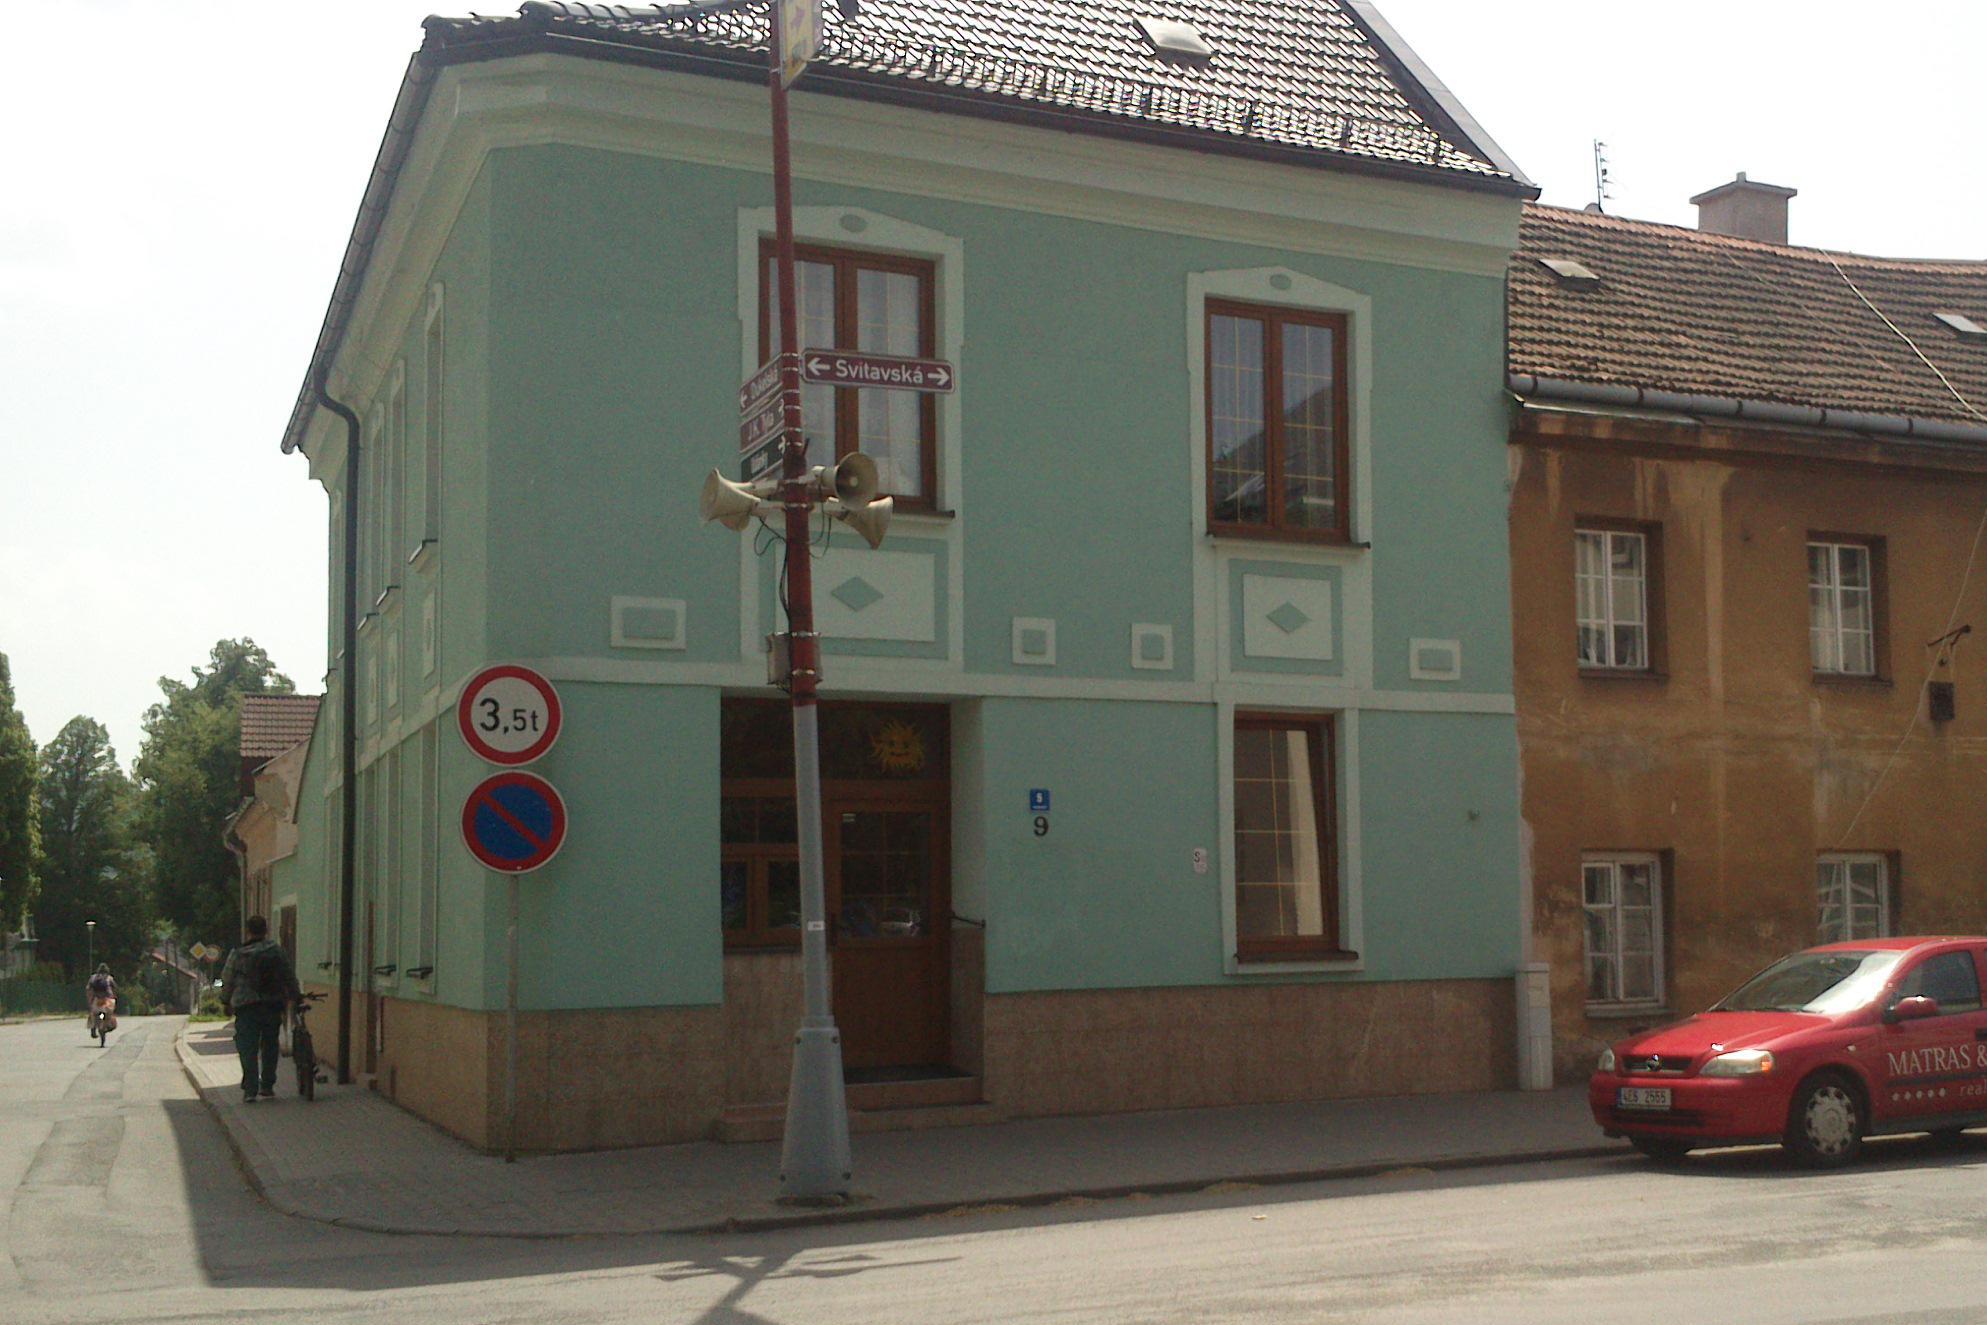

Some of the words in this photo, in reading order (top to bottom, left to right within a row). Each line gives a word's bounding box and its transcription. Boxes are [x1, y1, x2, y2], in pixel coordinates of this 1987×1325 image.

[835, 359, 924, 385] Svitavská
[1034, 816, 1049, 837] 9
[1888, 1044, 1971, 1076] MATRAS
[1977, 1045, 1987, 1067] &
